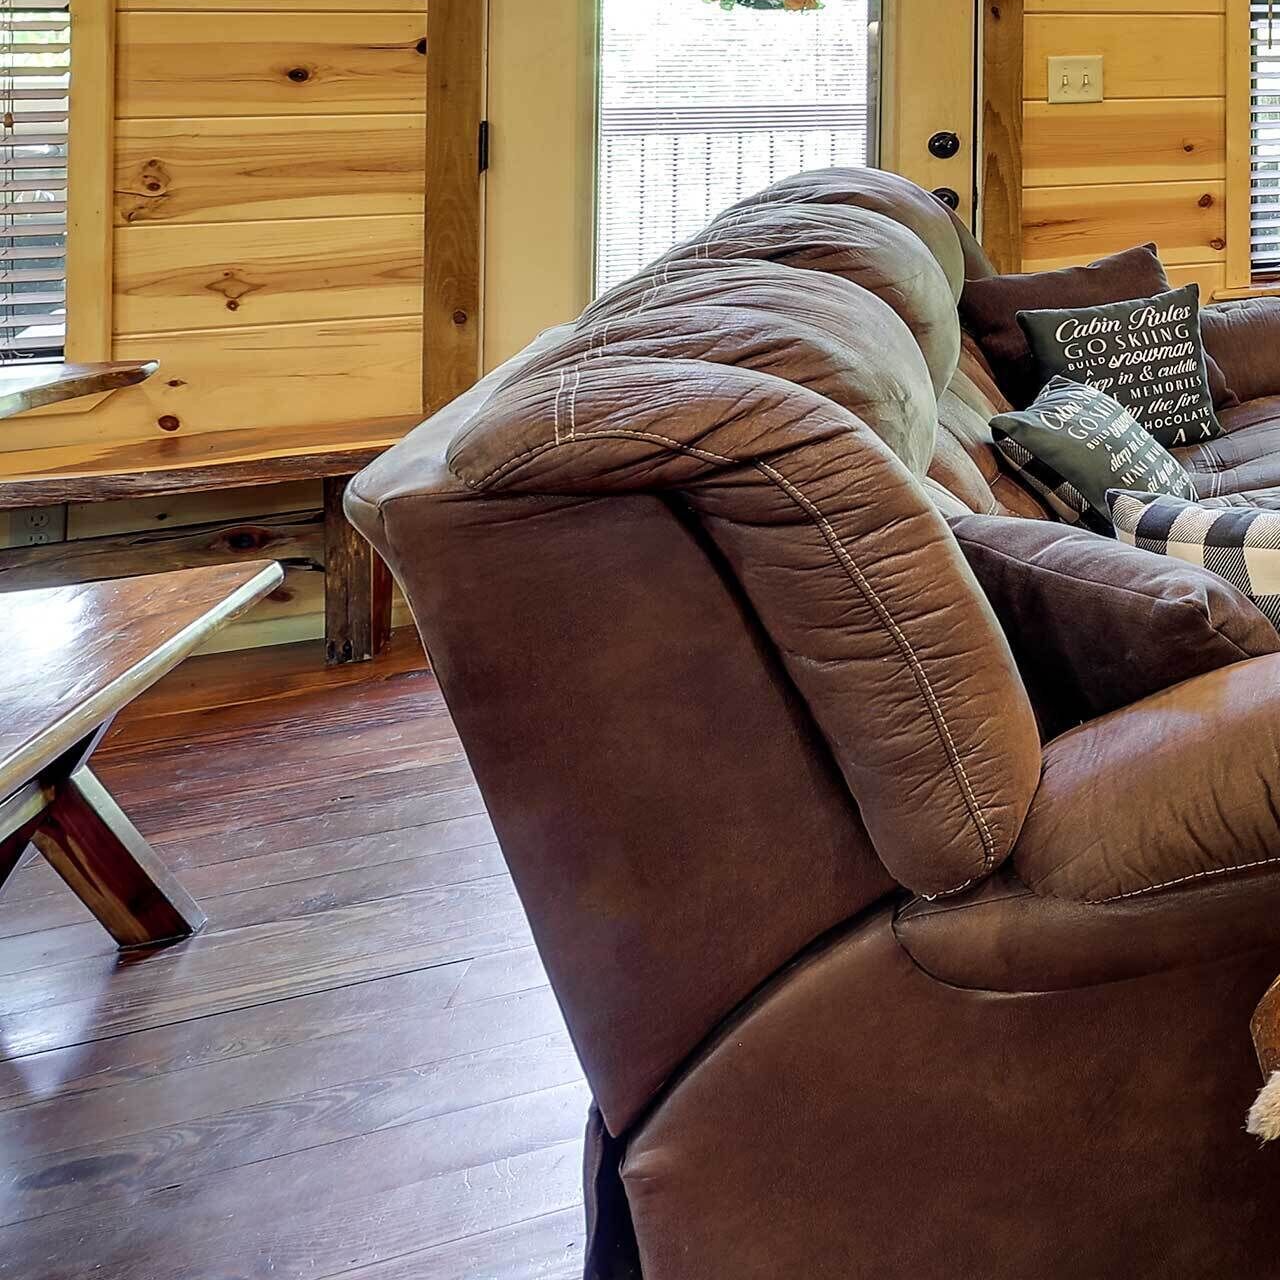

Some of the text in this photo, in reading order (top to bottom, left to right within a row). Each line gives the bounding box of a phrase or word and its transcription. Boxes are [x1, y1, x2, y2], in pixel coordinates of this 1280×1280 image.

[1055, 304, 1191, 343] Cabin Rules
[1064, 323, 1189, 359] GO SKIING
[1067, 341, 1195, 377] BUILD A snowman
[1118, 372, 1135, 386] in
[1139, 365, 1155, 381] &
[1157, 358, 1198, 378] cuddle
[1130, 376, 1202, 400] MEMORIES
[1147, 398, 1173, 415] the
[1170, 393, 1200, 415] fire
[1068, 417, 1098, 440] GO
[1144, 406, 1210, 430] HOCOLATE
[1086, 429, 1113, 451] BUILD A
